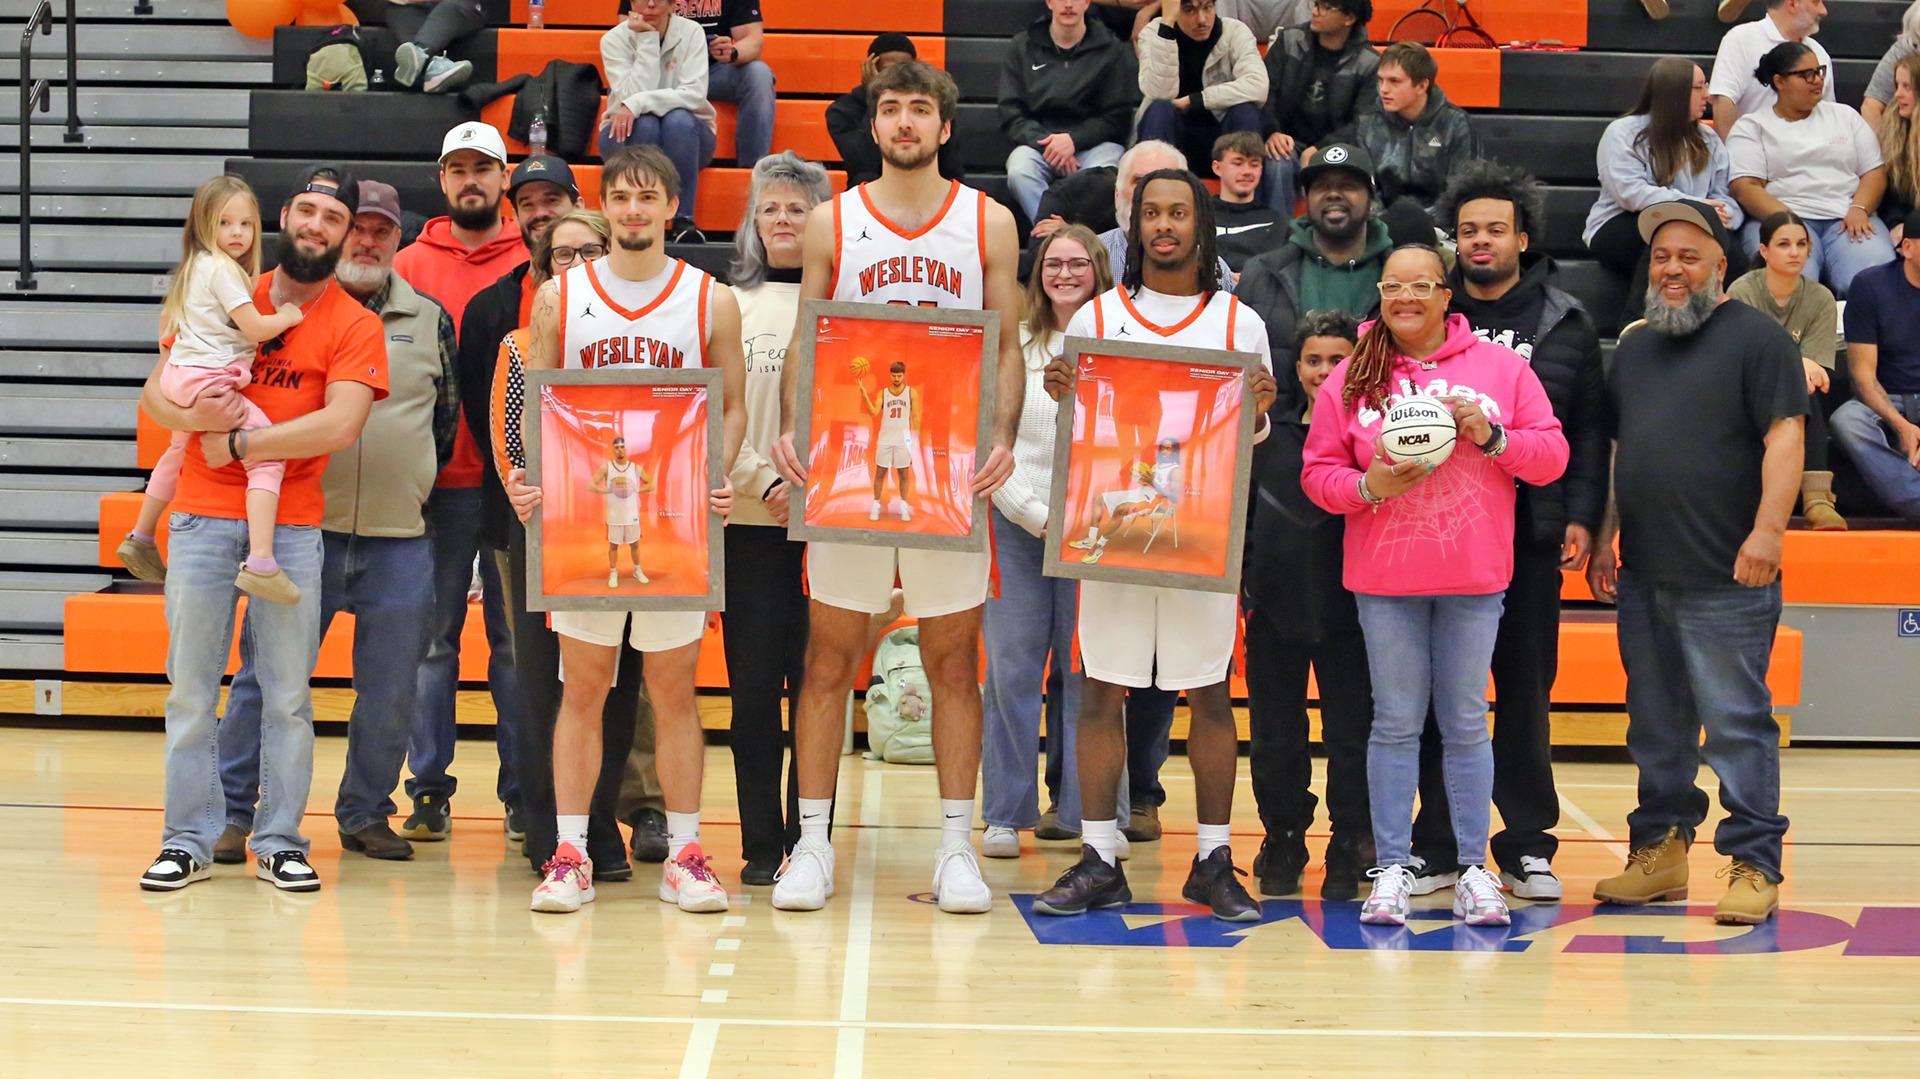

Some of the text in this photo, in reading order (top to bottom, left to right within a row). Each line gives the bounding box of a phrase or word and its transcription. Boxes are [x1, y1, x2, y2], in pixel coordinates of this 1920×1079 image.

[859, 256, 962, 299] WESLEYAN
[580, 336, 684, 368] WESLEYAN
[760, 365, 781, 373] ISAI
[1391, 406, 1438, 422] Wilson
[1398, 433, 1430, 445] NCAA
